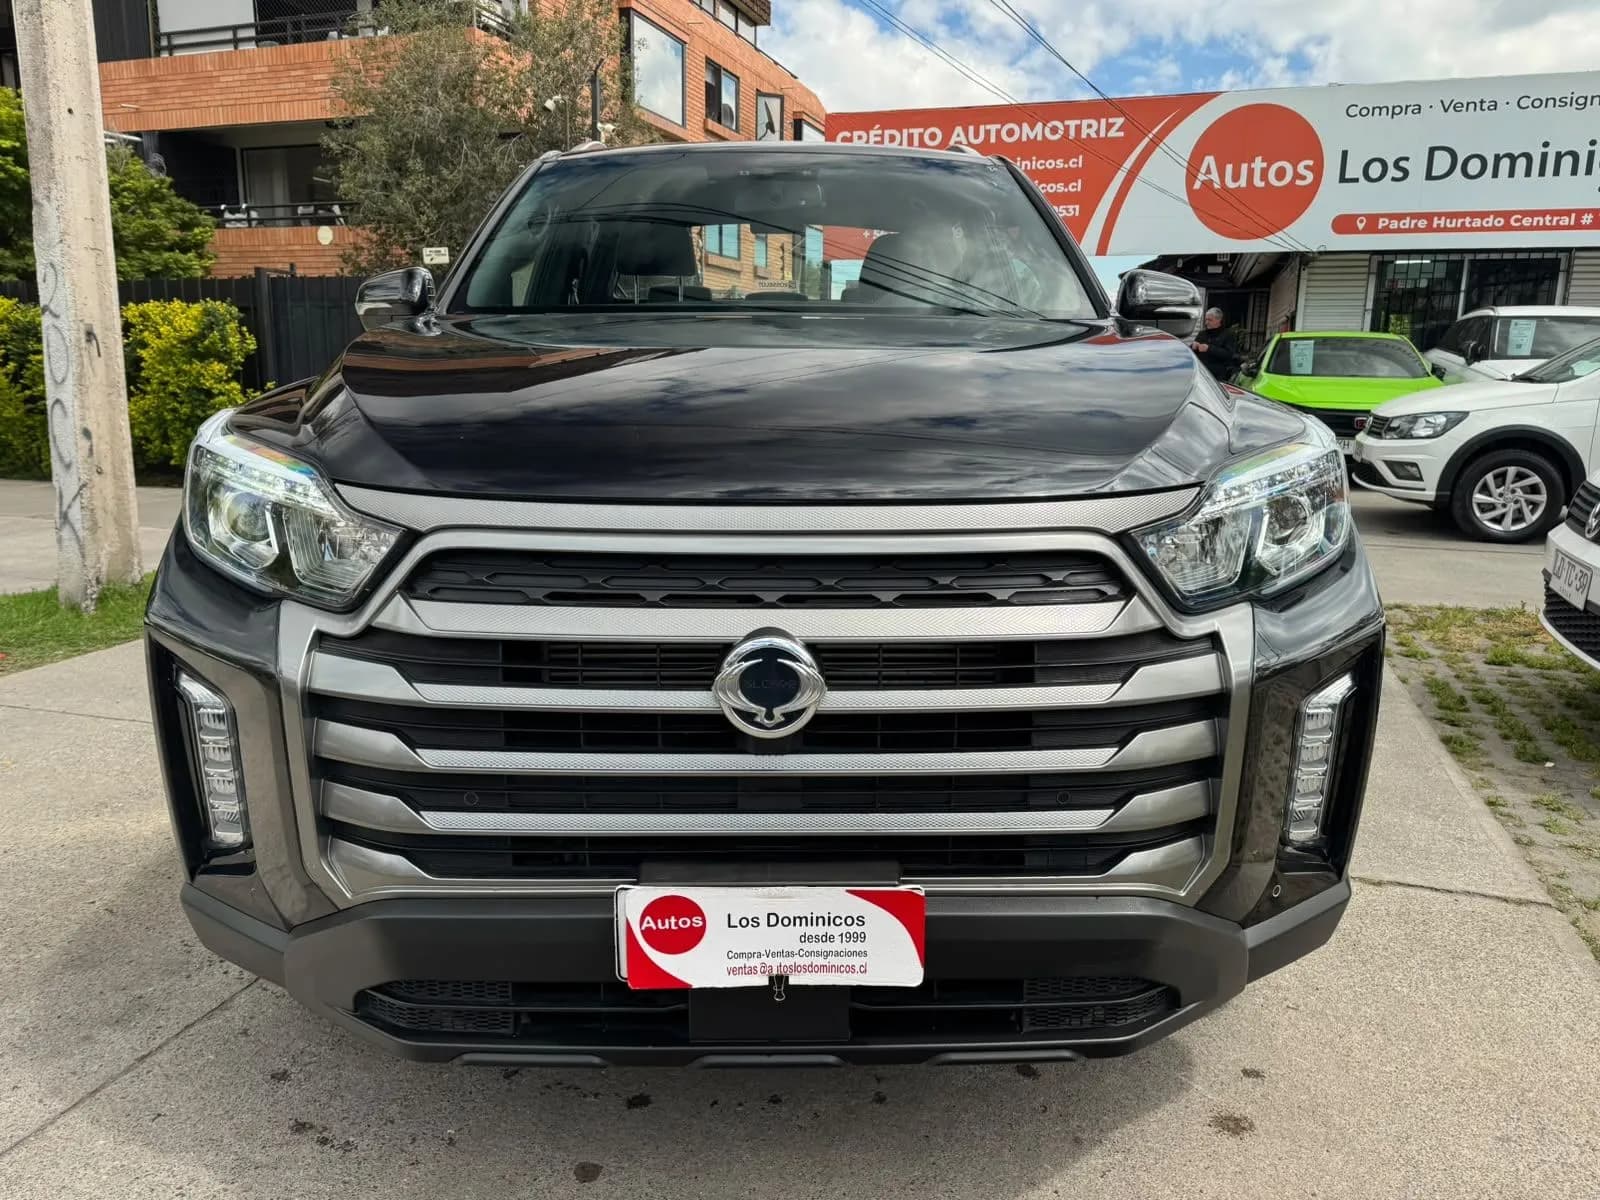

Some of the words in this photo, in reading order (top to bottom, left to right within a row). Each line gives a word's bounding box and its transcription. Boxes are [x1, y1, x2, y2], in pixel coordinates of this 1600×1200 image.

[1345, 103, 1422, 119] Compra
[1440, 98, 1498, 113] Venta
[836, 124, 943, 147] CRÉDITO
[949, 117, 1125, 145] AUTOMOTRIZ
[1338, 149, 1410, 184] Los
[1425, 139, 1600, 181] Domini
[1193, 155, 1315, 190] Autos
[1378, 216, 1428, 230] Padre
[1432, 214, 1505, 229] Hurtado
[1510, 212, 1576, 227] Central
[1580, 212, 1594, 226] #
[641, 915, 704, 931] Autos
[727, 912, 760, 929] Los
[767, 911, 866, 928] Dominicos
[799, 931, 835, 944] desde
[838, 931, 867, 944] 1999
[726, 947, 868, 961] Compra-Ventas-Consignaciones
